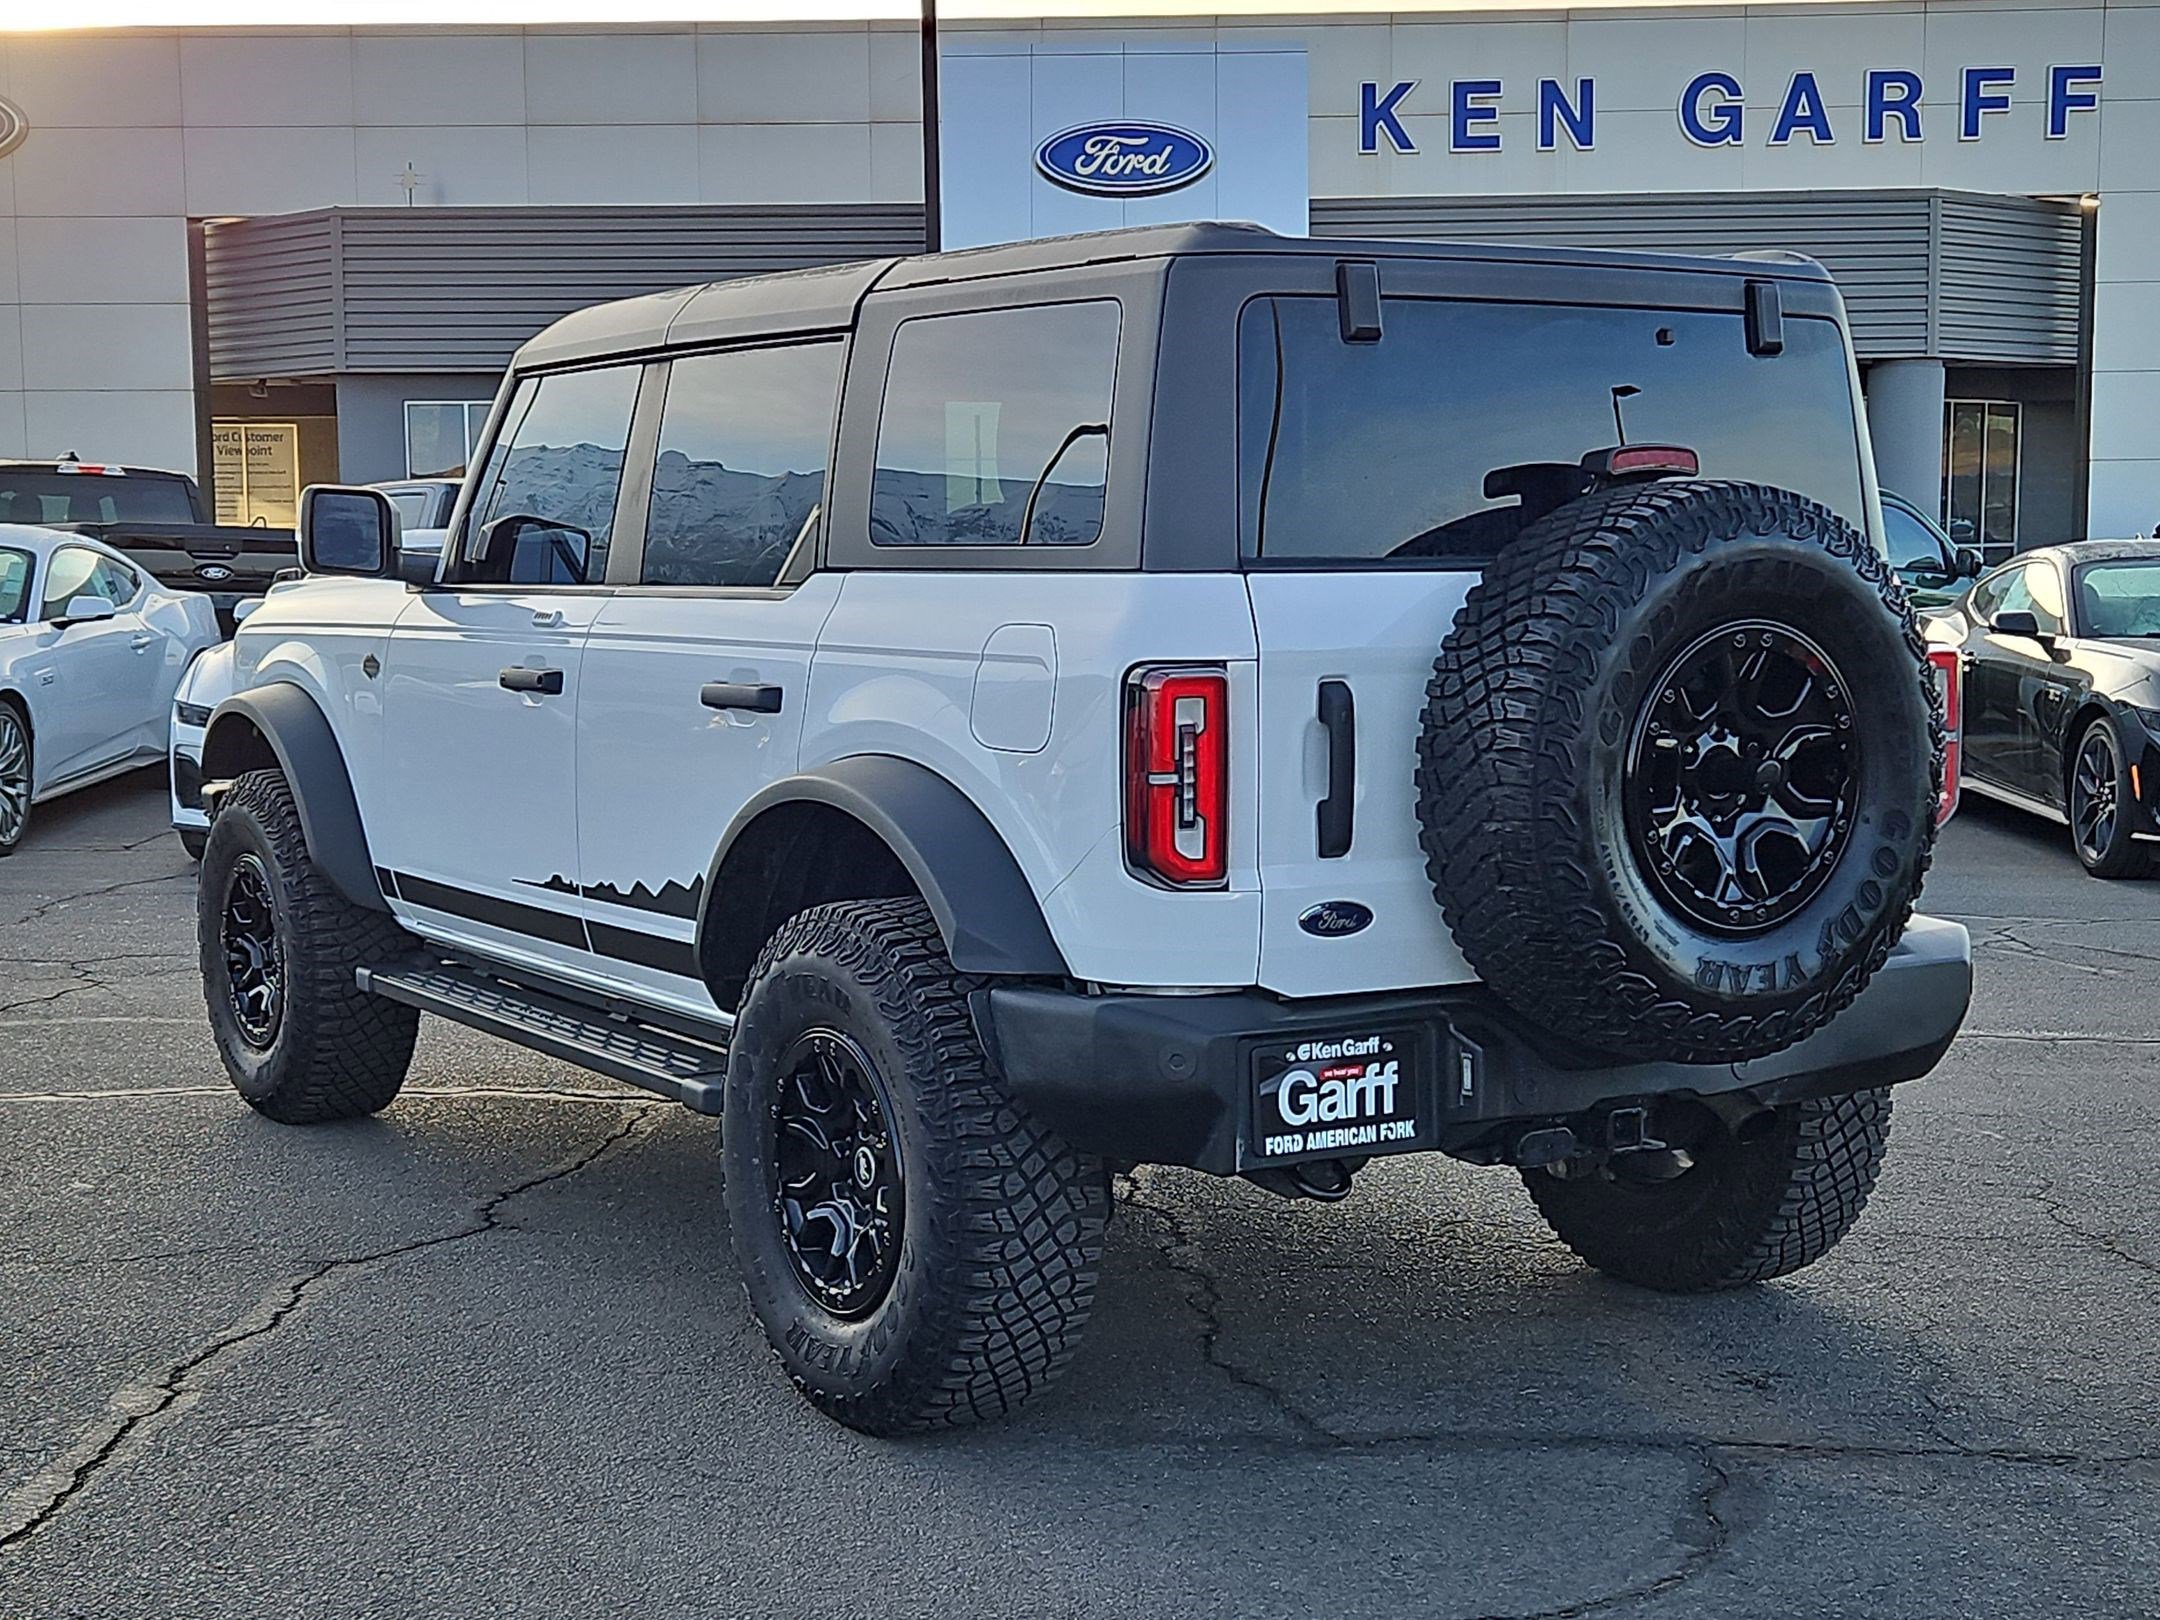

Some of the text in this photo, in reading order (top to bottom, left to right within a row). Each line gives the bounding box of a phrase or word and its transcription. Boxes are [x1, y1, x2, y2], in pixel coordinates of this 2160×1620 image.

[1358, 64, 2102, 153] KEN GARFF
[1074, 135, 1174, 176] Ford
[213, 431, 229, 442] ord
[216, 445, 272, 456] Viewoint
[1318, 910, 1358, 930] Ford
[1342, 1036, 1380, 1057] Garff
[1278, 1061, 1398, 1126] Garff
[1265, 1120, 1416, 1156] FORD AMERICAN FORK
